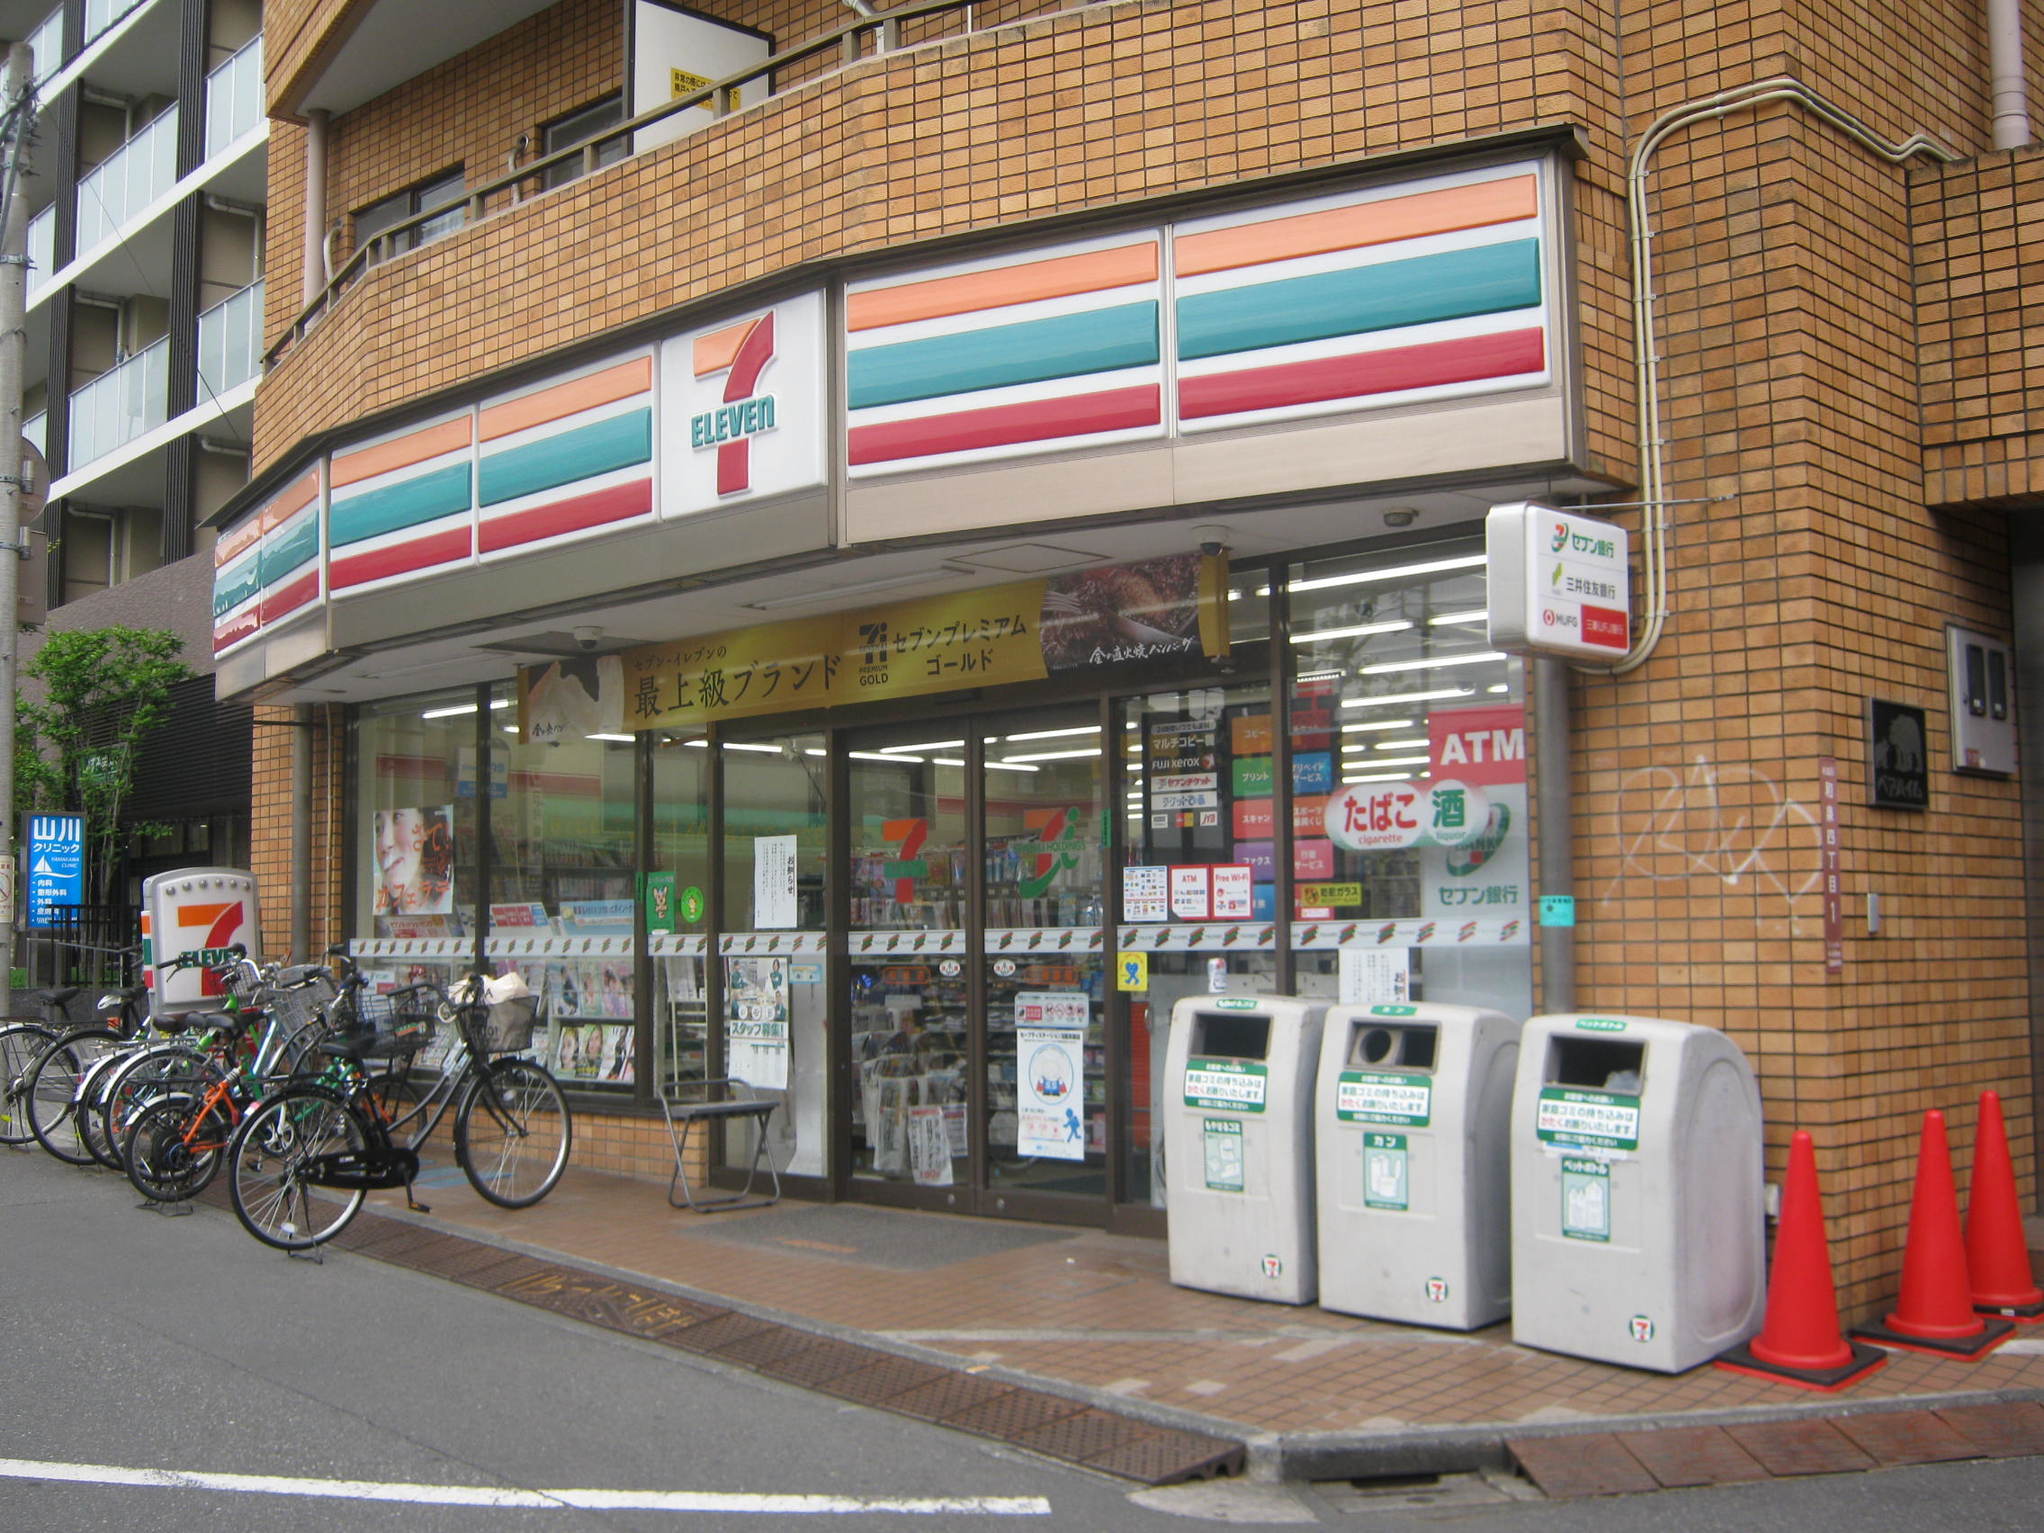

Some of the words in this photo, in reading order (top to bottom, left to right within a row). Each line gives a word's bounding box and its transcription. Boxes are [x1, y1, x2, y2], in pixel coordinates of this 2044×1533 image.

[693, 310, 774, 496] 7
[1573, 533, 1614, 558] セブン銀行
[1566, 576, 1615, 600] 三井住友銀行
[893, 615, 1027, 653] セブンプレミアム
[926, 648, 993, 675] ゴールド
[635, 655, 841, 719] 最上級ブランド
[859, 673, 889, 686] GOLD
[1153, 735, 1215, 749] マルチコピー
[1440, 728, 1524, 766] ATM
[1344, 793, 1418, 832] たばこ
[1432, 789, 1466, 828] 酒
[34, 817, 80, 842] 山川
[1358, 835, 1403, 846] cigarette
[33, 843, 80, 853] クリニック
[1439, 886, 1519, 905] セブン銀行
[1374, 1135, 1397, 1148] カン
